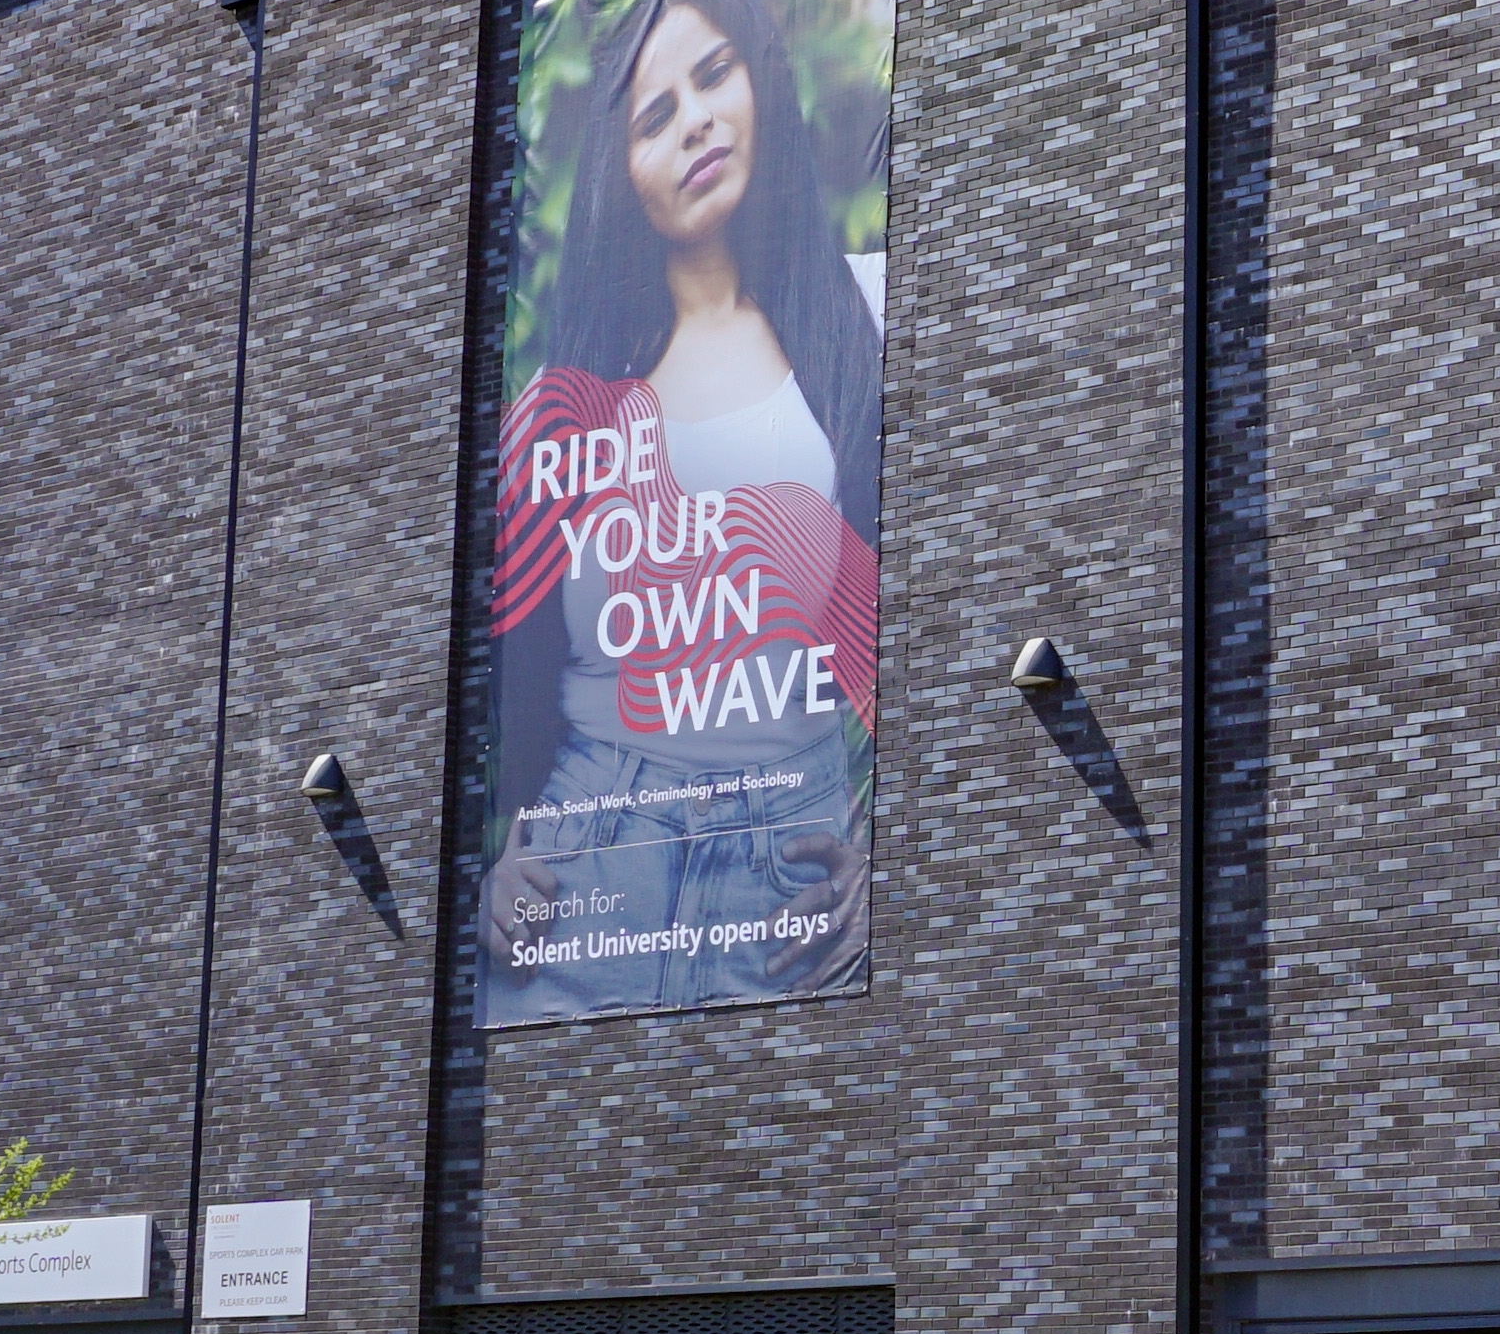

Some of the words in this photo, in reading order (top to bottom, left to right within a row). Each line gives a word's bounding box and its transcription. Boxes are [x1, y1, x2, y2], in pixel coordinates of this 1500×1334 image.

[531, 417, 657, 505] RIDE
[558, 489, 730, 580] YOUR
[596, 568, 760, 658] OWN
[654, 643, 837, 736] WAVE
[517, 805, 561, 821] Anisha,
[562, 796, 598, 816] Social
[600, 793, 637, 811] Work,
[638, 781, 714, 805] Criminology
[716, 778, 740, 794] and
[742, 770, 805, 790] Sociology
[513, 890, 583, 924] Search
[589, 887, 626, 914] for:
[511, 934, 581, 968] Solent
[587, 923, 705, 958] University
[709, 919, 767, 952] open
[774, 909, 829, 945] days
[210, 1213, 240, 1224] SOLENT
[28, 1249, 92, 1281] Complex
[209, 1250, 235, 1260] SPORTS
[236, 1248, 270, 1258] COMPLEX
[270, 1247, 284, 1257] CAR
[285, 1247, 304, 1255] PARK
[220, 1297, 245, 1307] PLEASE
[246, 1296, 264, 1306] KEEP
[265, 1295, 288, 1305] CLEAR
[221, 1270, 289, 1288] ENTRANCE
